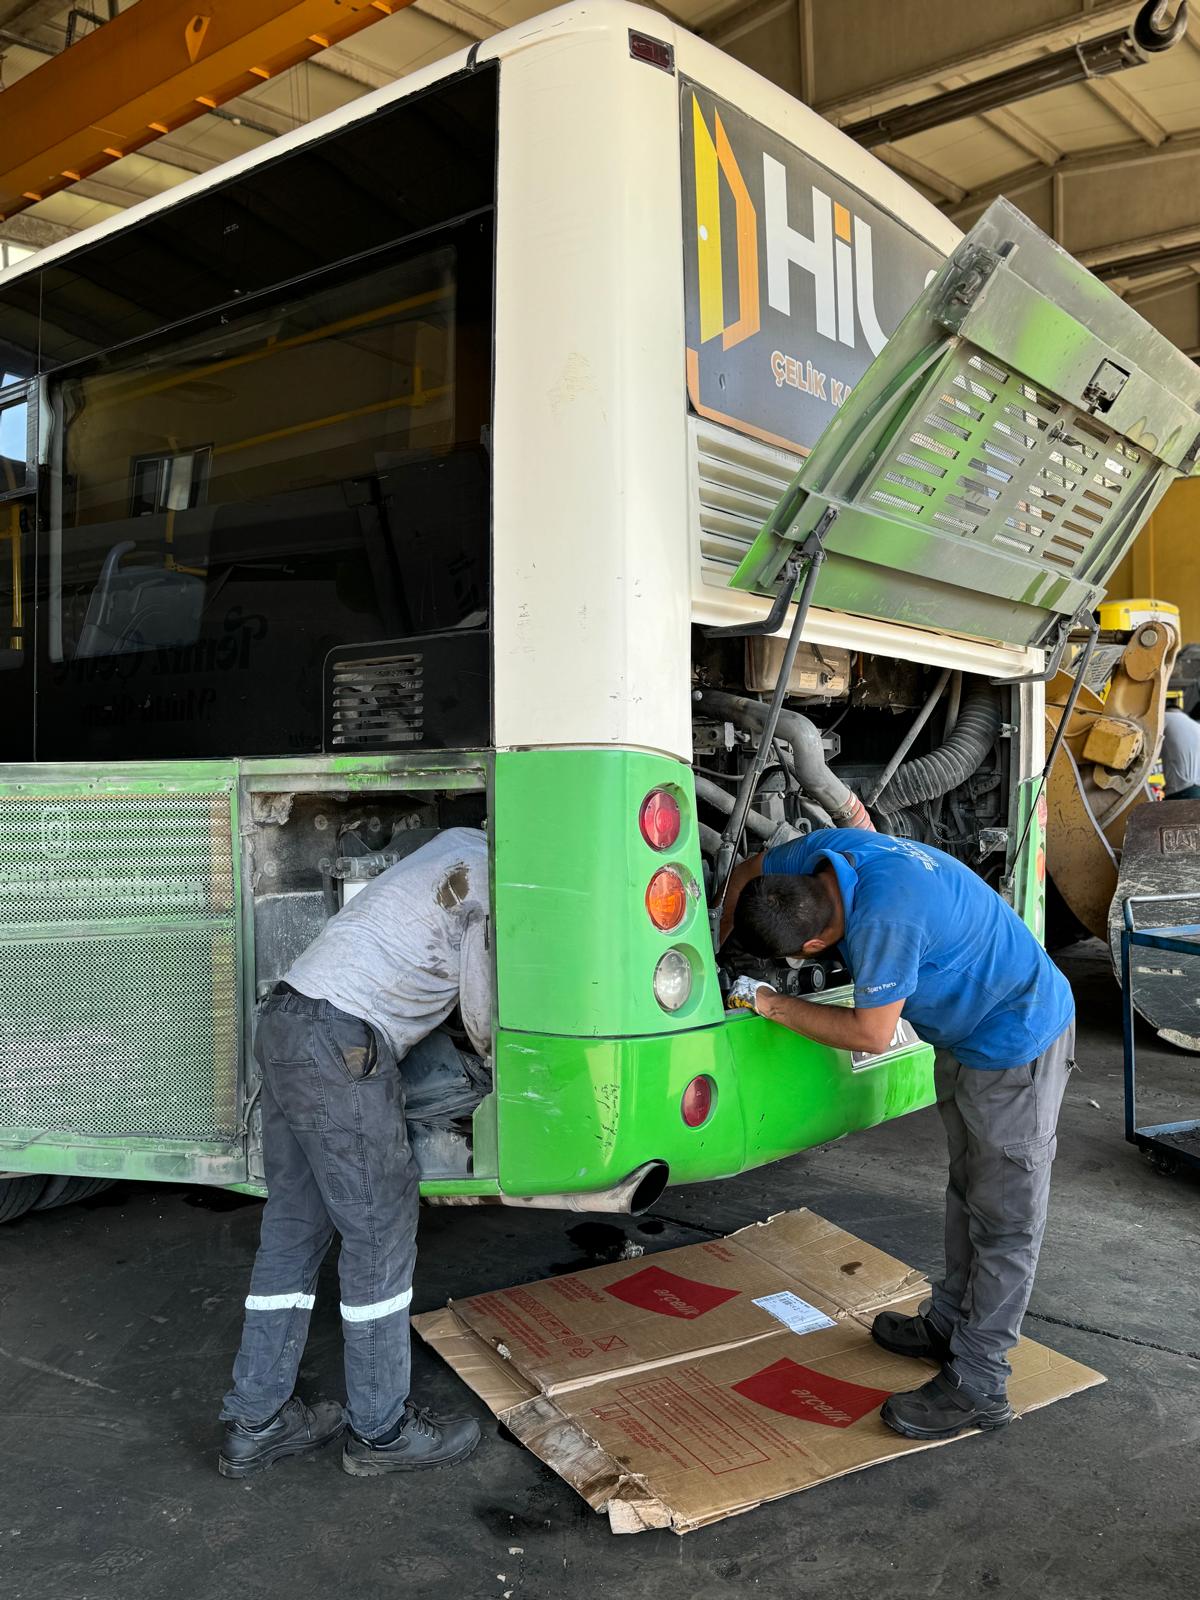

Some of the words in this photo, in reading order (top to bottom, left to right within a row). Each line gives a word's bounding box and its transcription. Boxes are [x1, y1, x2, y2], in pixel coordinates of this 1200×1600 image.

[770, 350, 827, 401] ÇELİK
[882, 981, 897, 990] Parts
[653, 1288, 700, 1315] arçelik
[791, 1388, 852, 1422] arçelik
